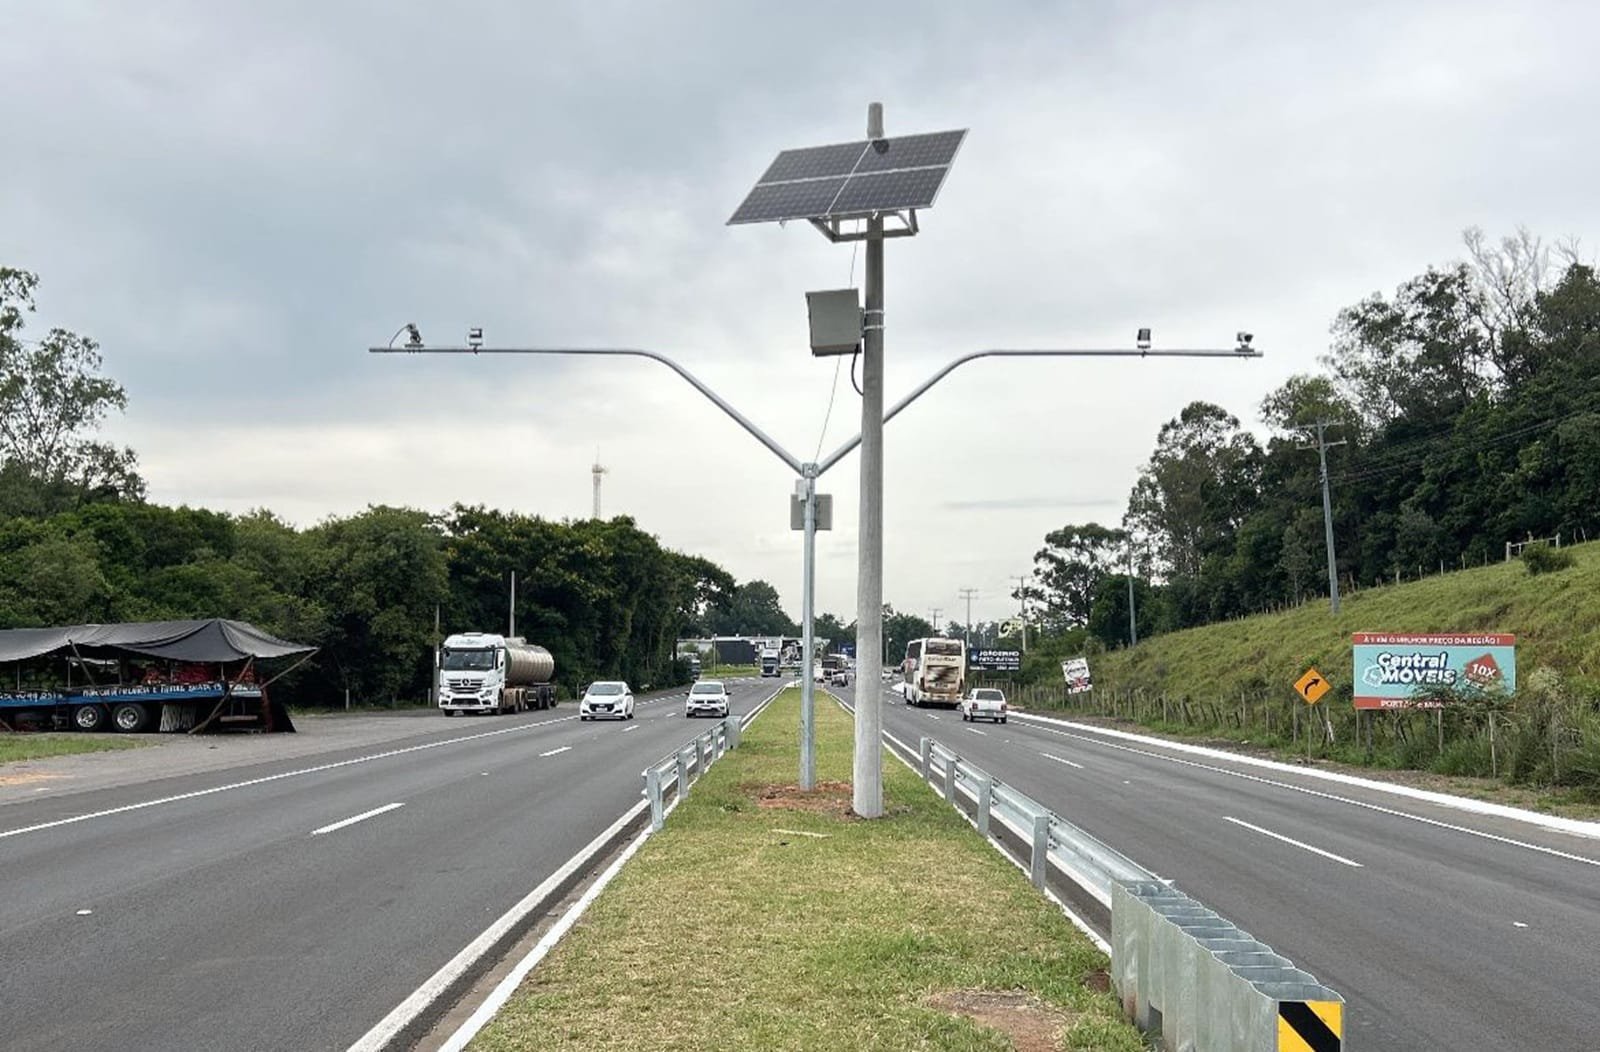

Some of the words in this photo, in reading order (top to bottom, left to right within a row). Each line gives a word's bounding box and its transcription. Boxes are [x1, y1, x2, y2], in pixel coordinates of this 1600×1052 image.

[1429, 637, 1453, 645] PREÇO
[1378, 652, 1447, 668] Central
[1472, 663, 1497, 677] 10X
